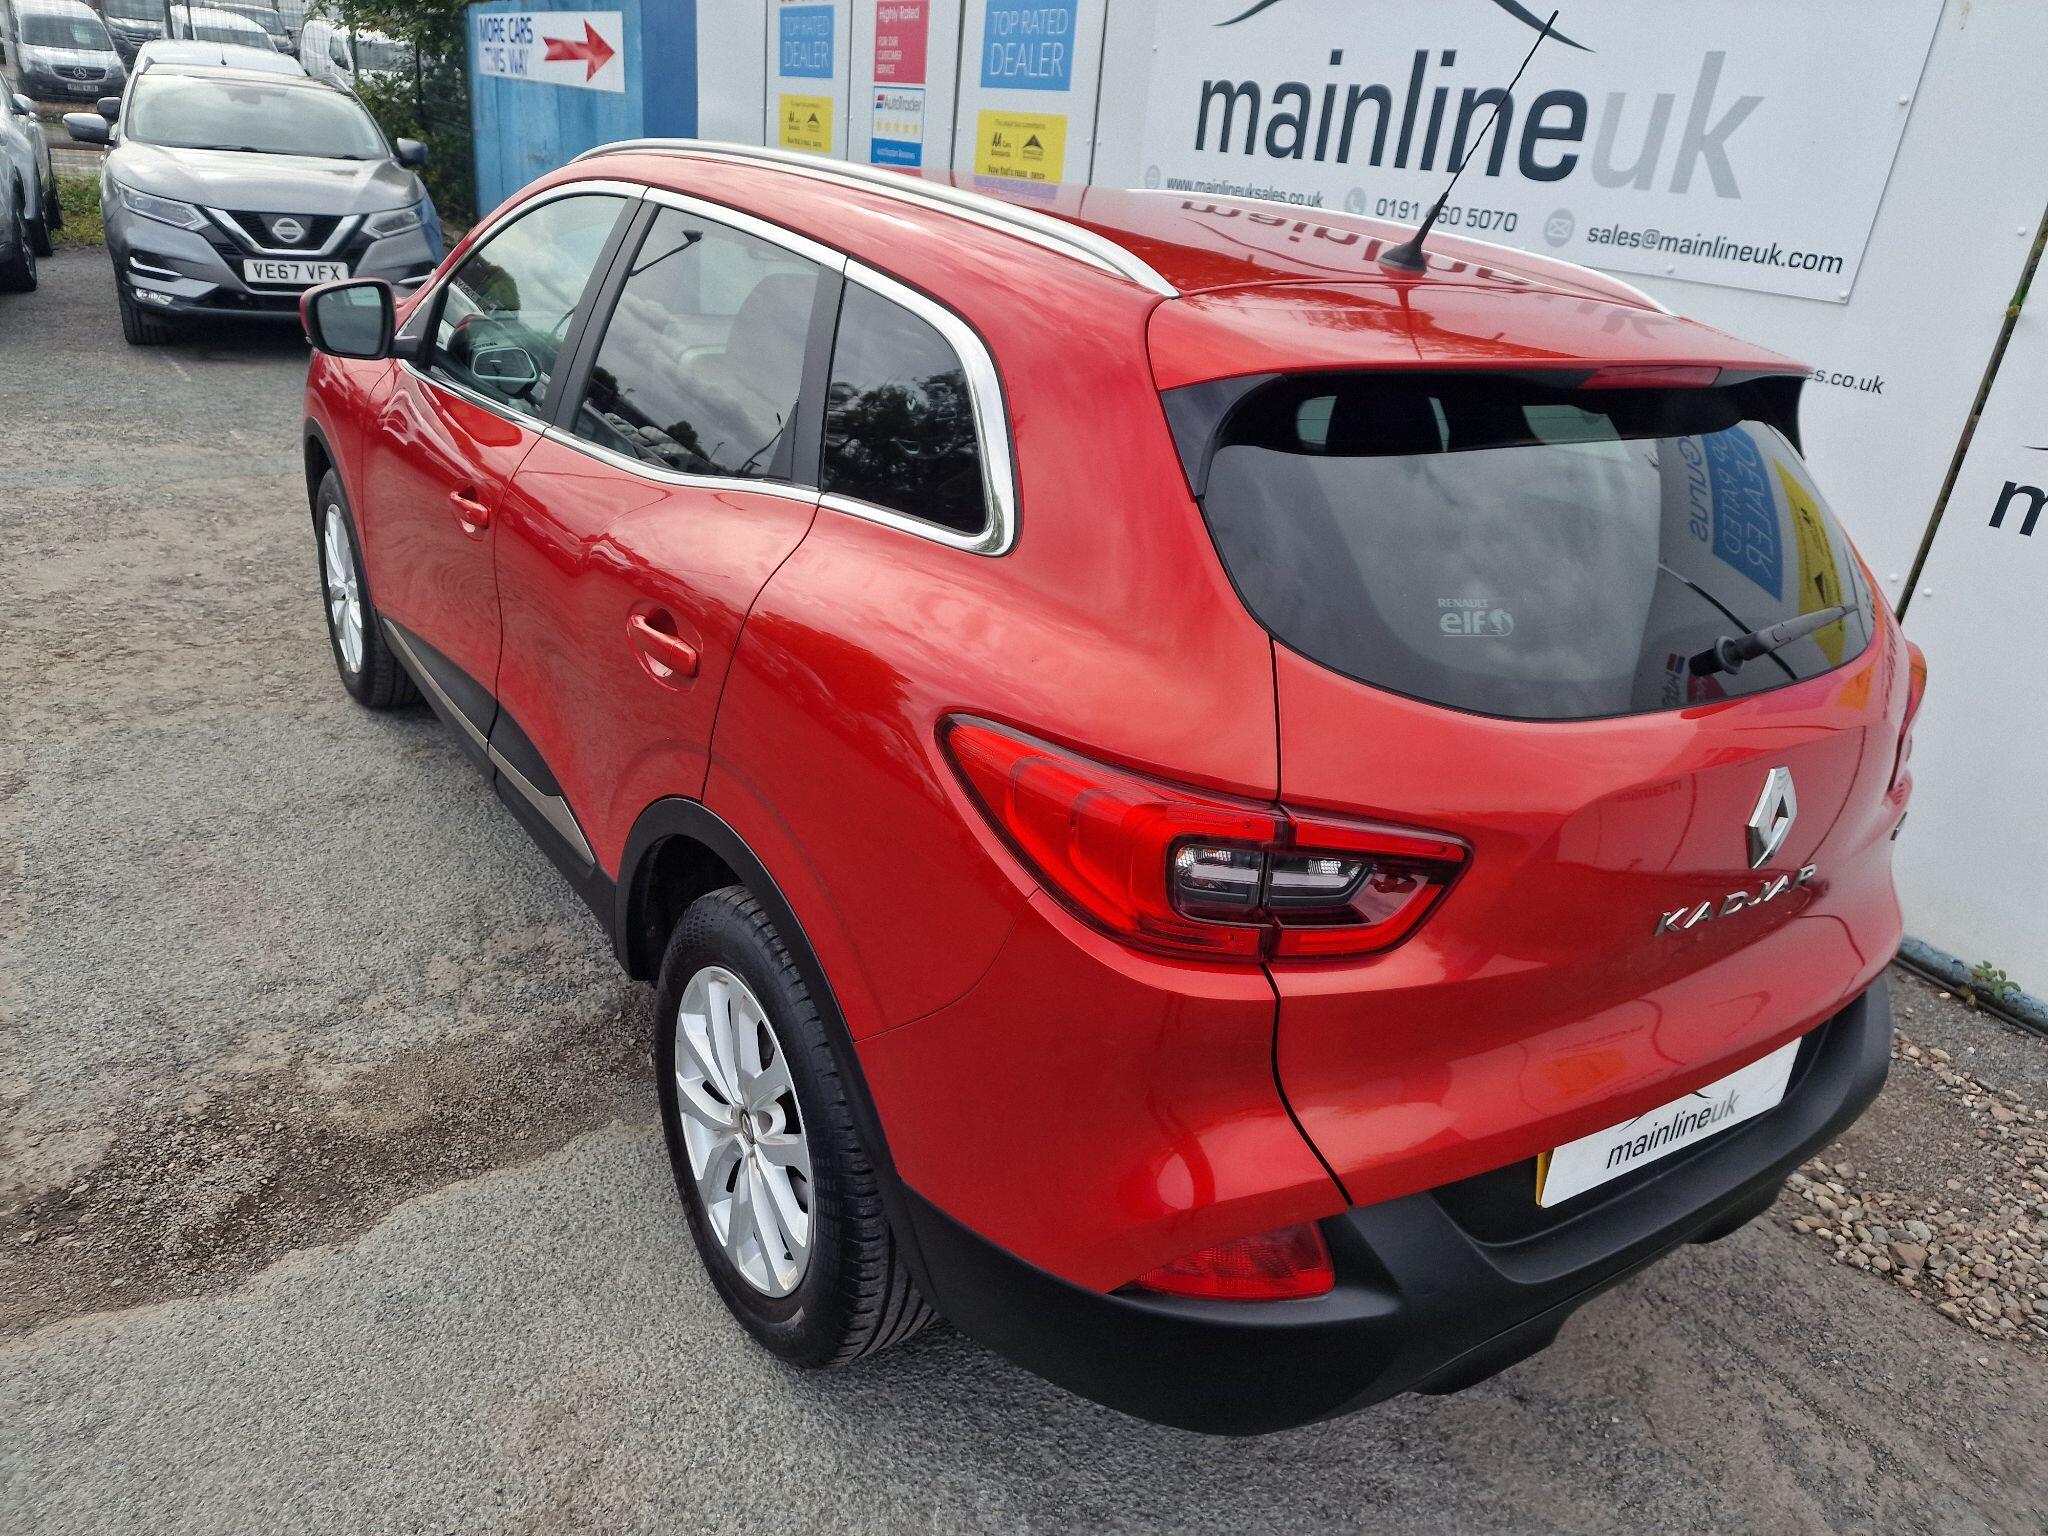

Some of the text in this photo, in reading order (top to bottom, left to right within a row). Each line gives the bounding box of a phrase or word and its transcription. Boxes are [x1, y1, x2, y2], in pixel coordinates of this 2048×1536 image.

[479, 16, 533, 44] MORE CARS
[783, 15, 830, 36] TOP RATED
[991, 8, 1069, 36] TOP RATED
[485, 47, 529, 74] THIS WAY
[783, 40, 830, 68] DEALER
[989, 42, 1065, 77] DEALER
[1195, 49, 1766, 200] mainlineuk
[1376, 198, 1518, 232] 0191 60 5070
[1587, 223, 1844, 275] sales@mainlineuk.com
[253, 263, 341, 280] VE67 VFX
[1438, 597, 1489, 609] RENAULT
[1440, 610, 1486, 634] elf
[1652, 863, 1818, 938] KADJAR
[1606, 1088, 1741, 1170] mainlineuk
